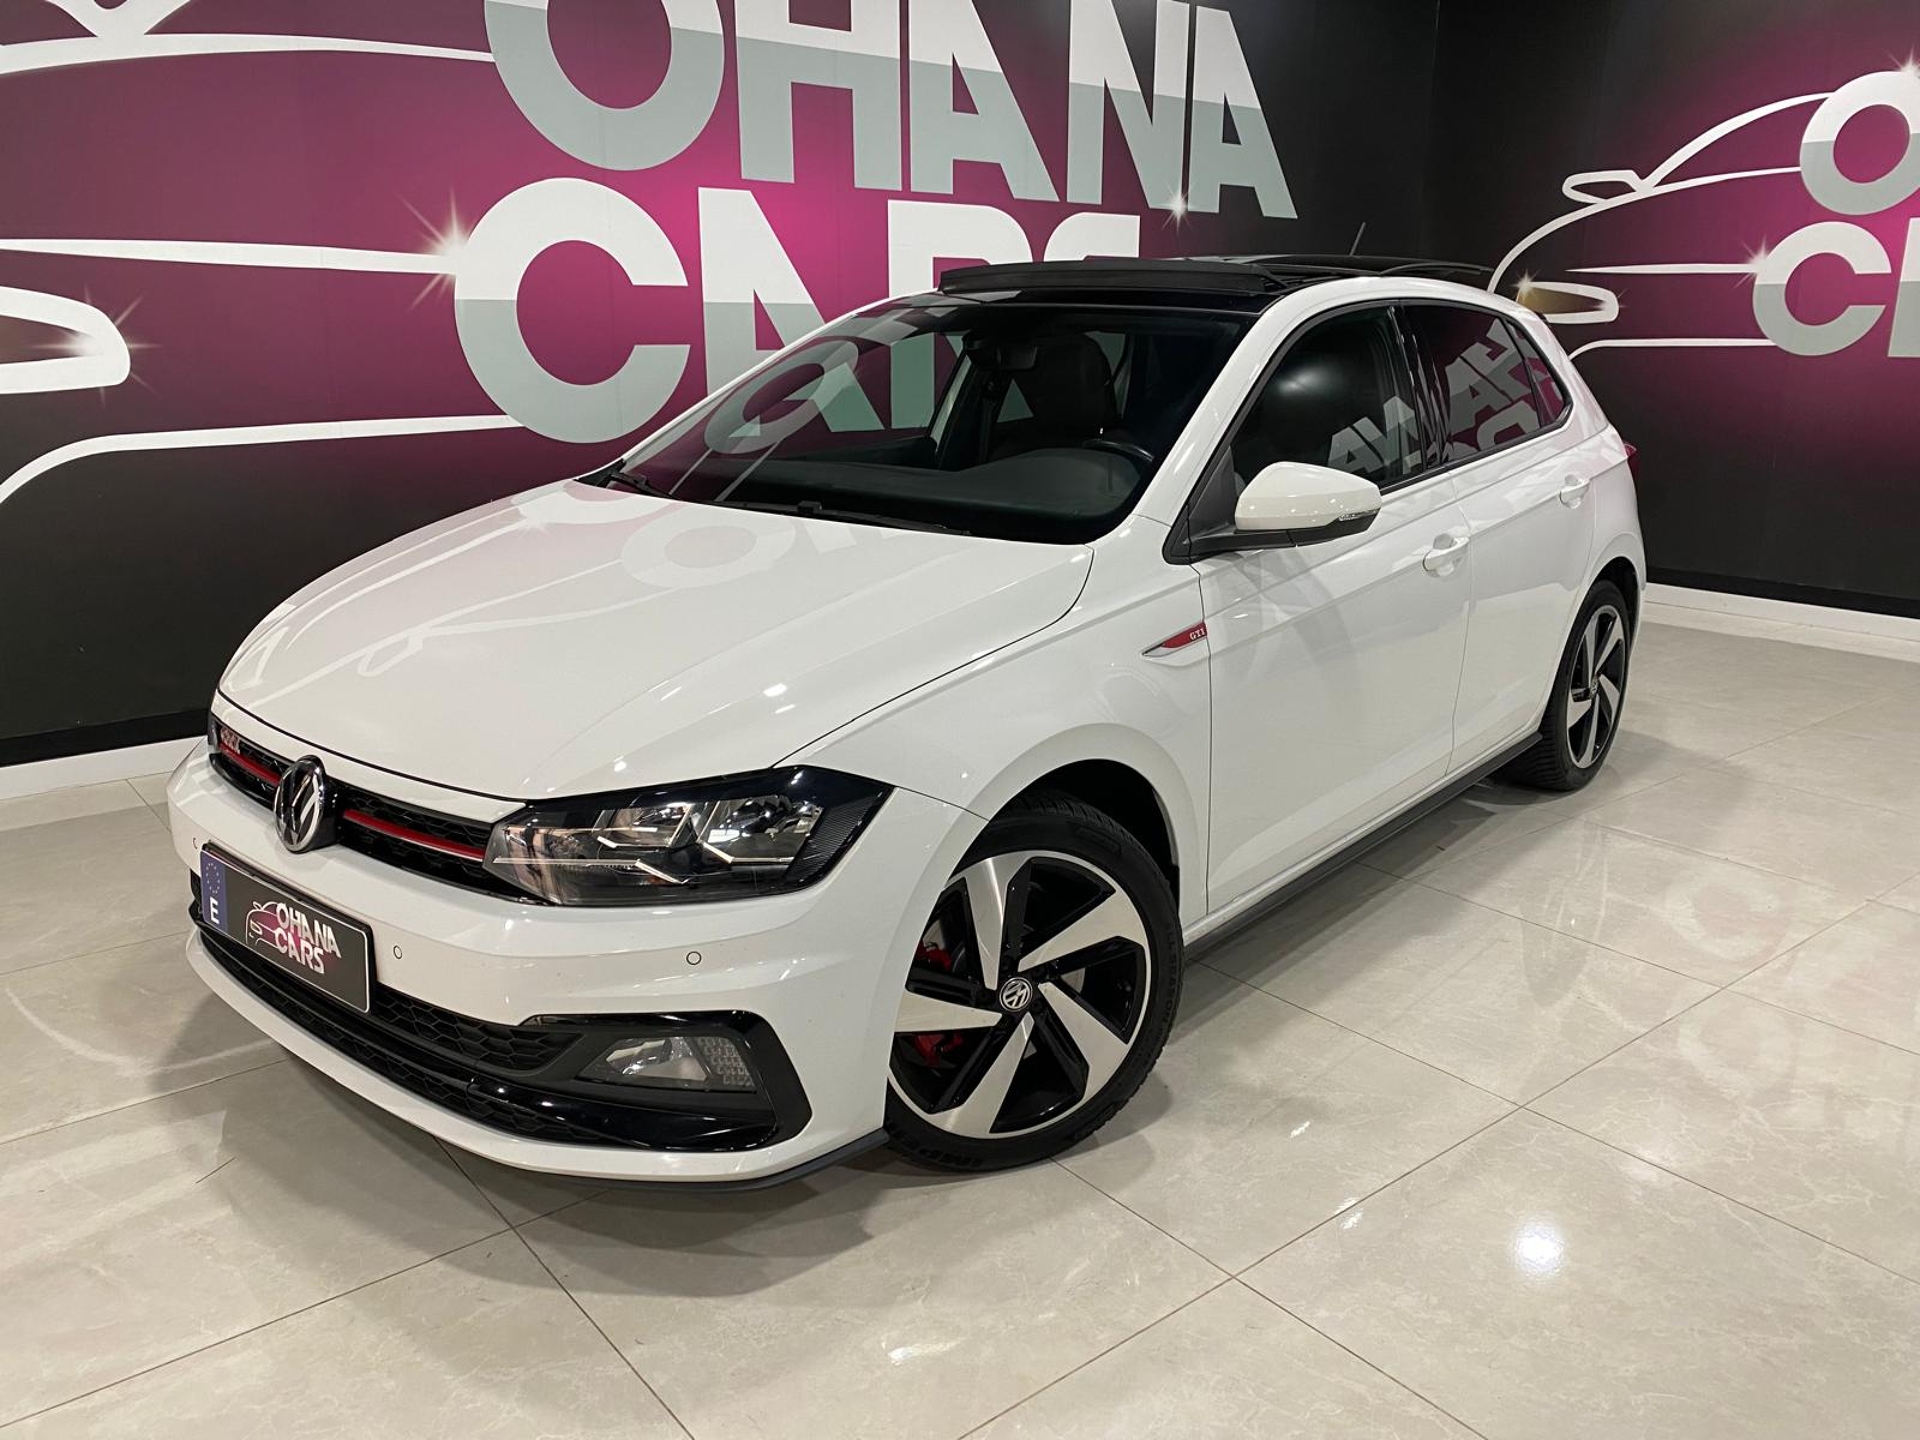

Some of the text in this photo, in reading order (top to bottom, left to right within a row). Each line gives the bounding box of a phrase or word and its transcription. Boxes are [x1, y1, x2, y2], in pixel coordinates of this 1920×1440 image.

[485, 0, 1297, 219] OHANA
[1189, 628, 1206, 640] GTI
[209, 896, 220, 925] E
[276, 902, 341, 959] OHANA
[275, 927, 325, 974] CARS
